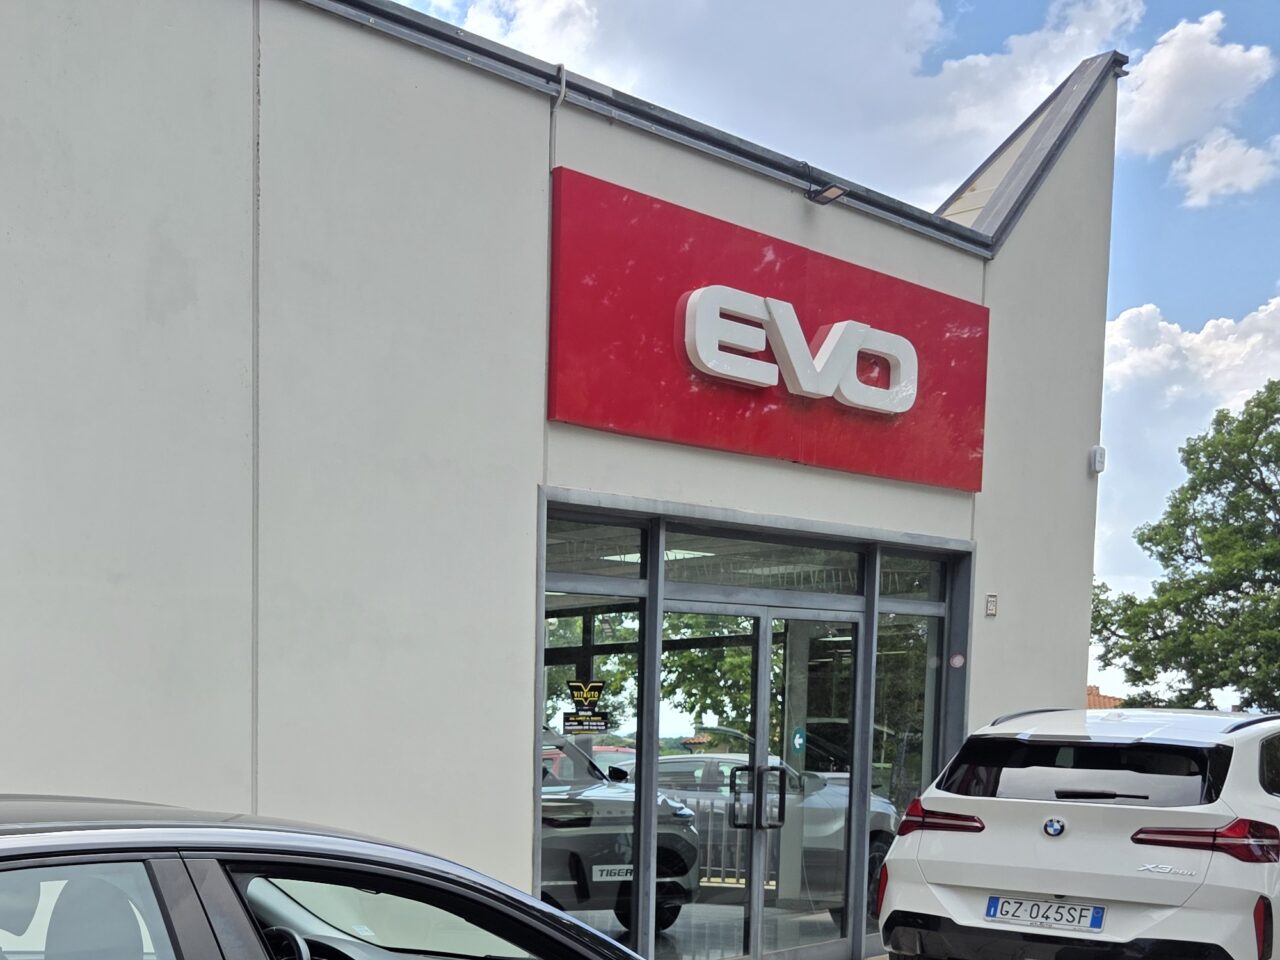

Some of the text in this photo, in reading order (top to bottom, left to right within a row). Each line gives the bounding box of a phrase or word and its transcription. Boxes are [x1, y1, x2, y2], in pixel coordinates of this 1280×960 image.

[684, 285, 918, 413] EVO
[1000, 900, 1023, 918] GZ
[1029, 903, 1090, 924] 045SF
